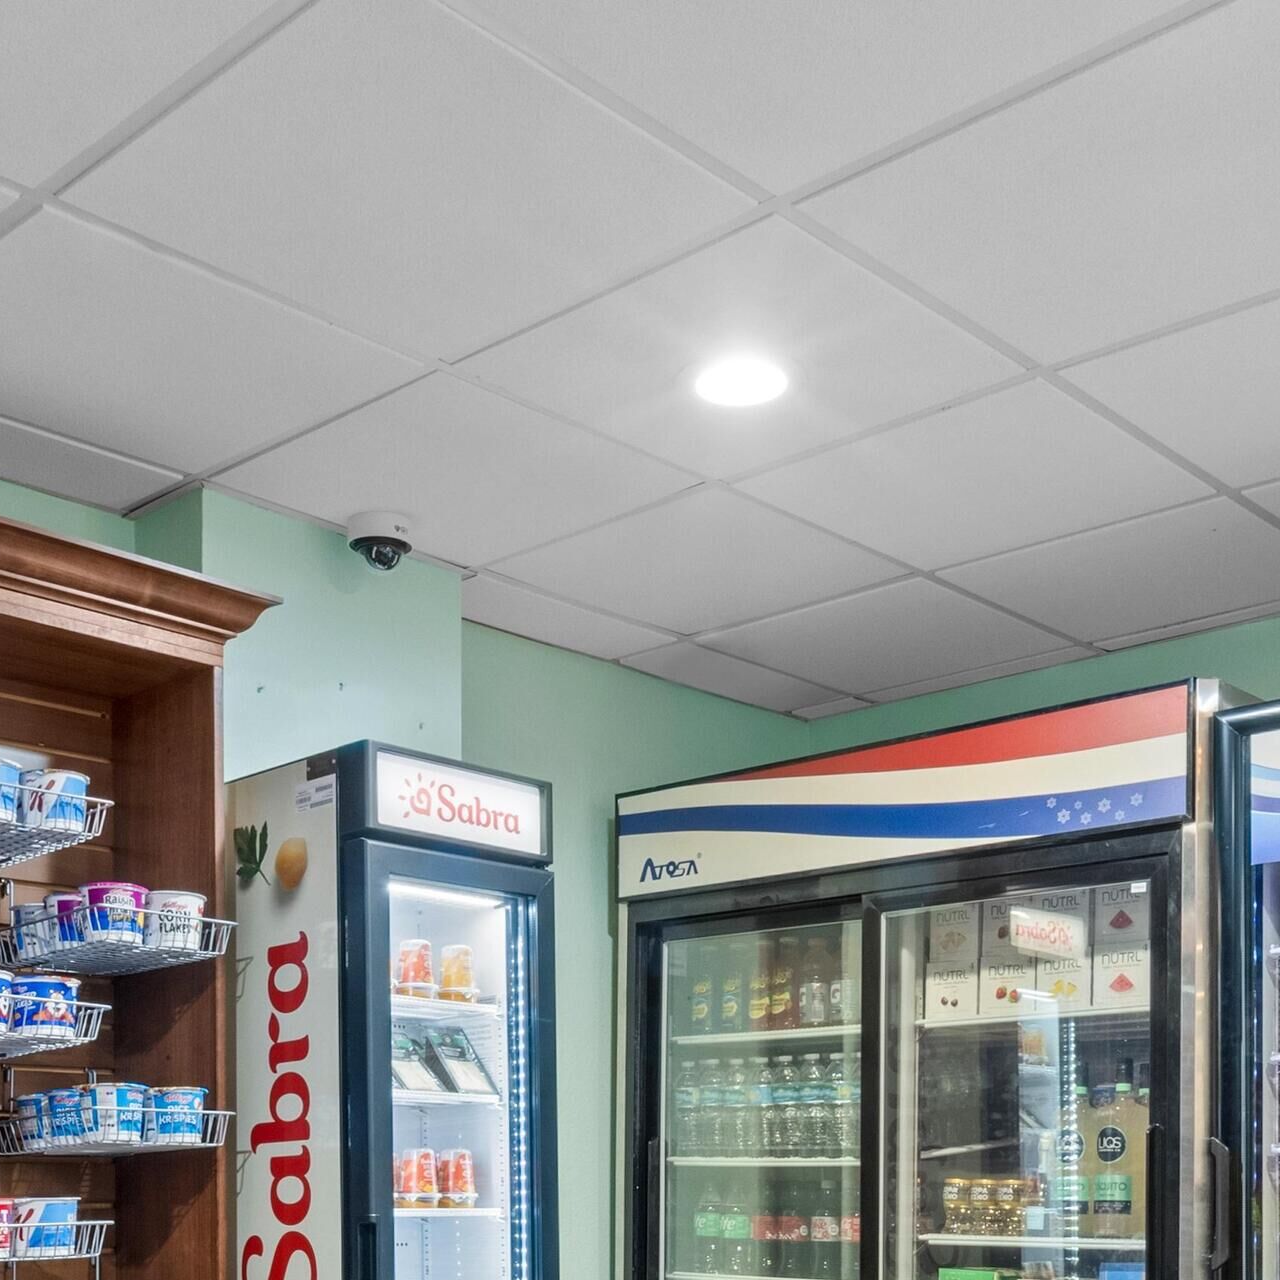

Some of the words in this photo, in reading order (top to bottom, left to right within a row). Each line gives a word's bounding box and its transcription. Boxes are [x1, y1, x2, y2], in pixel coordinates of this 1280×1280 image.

[437, 782, 521, 835] Sabra
[640, 857, 699, 883] ATOSA
[105, 895, 134, 905] Raisin
[158, 910, 191, 923] CORN
